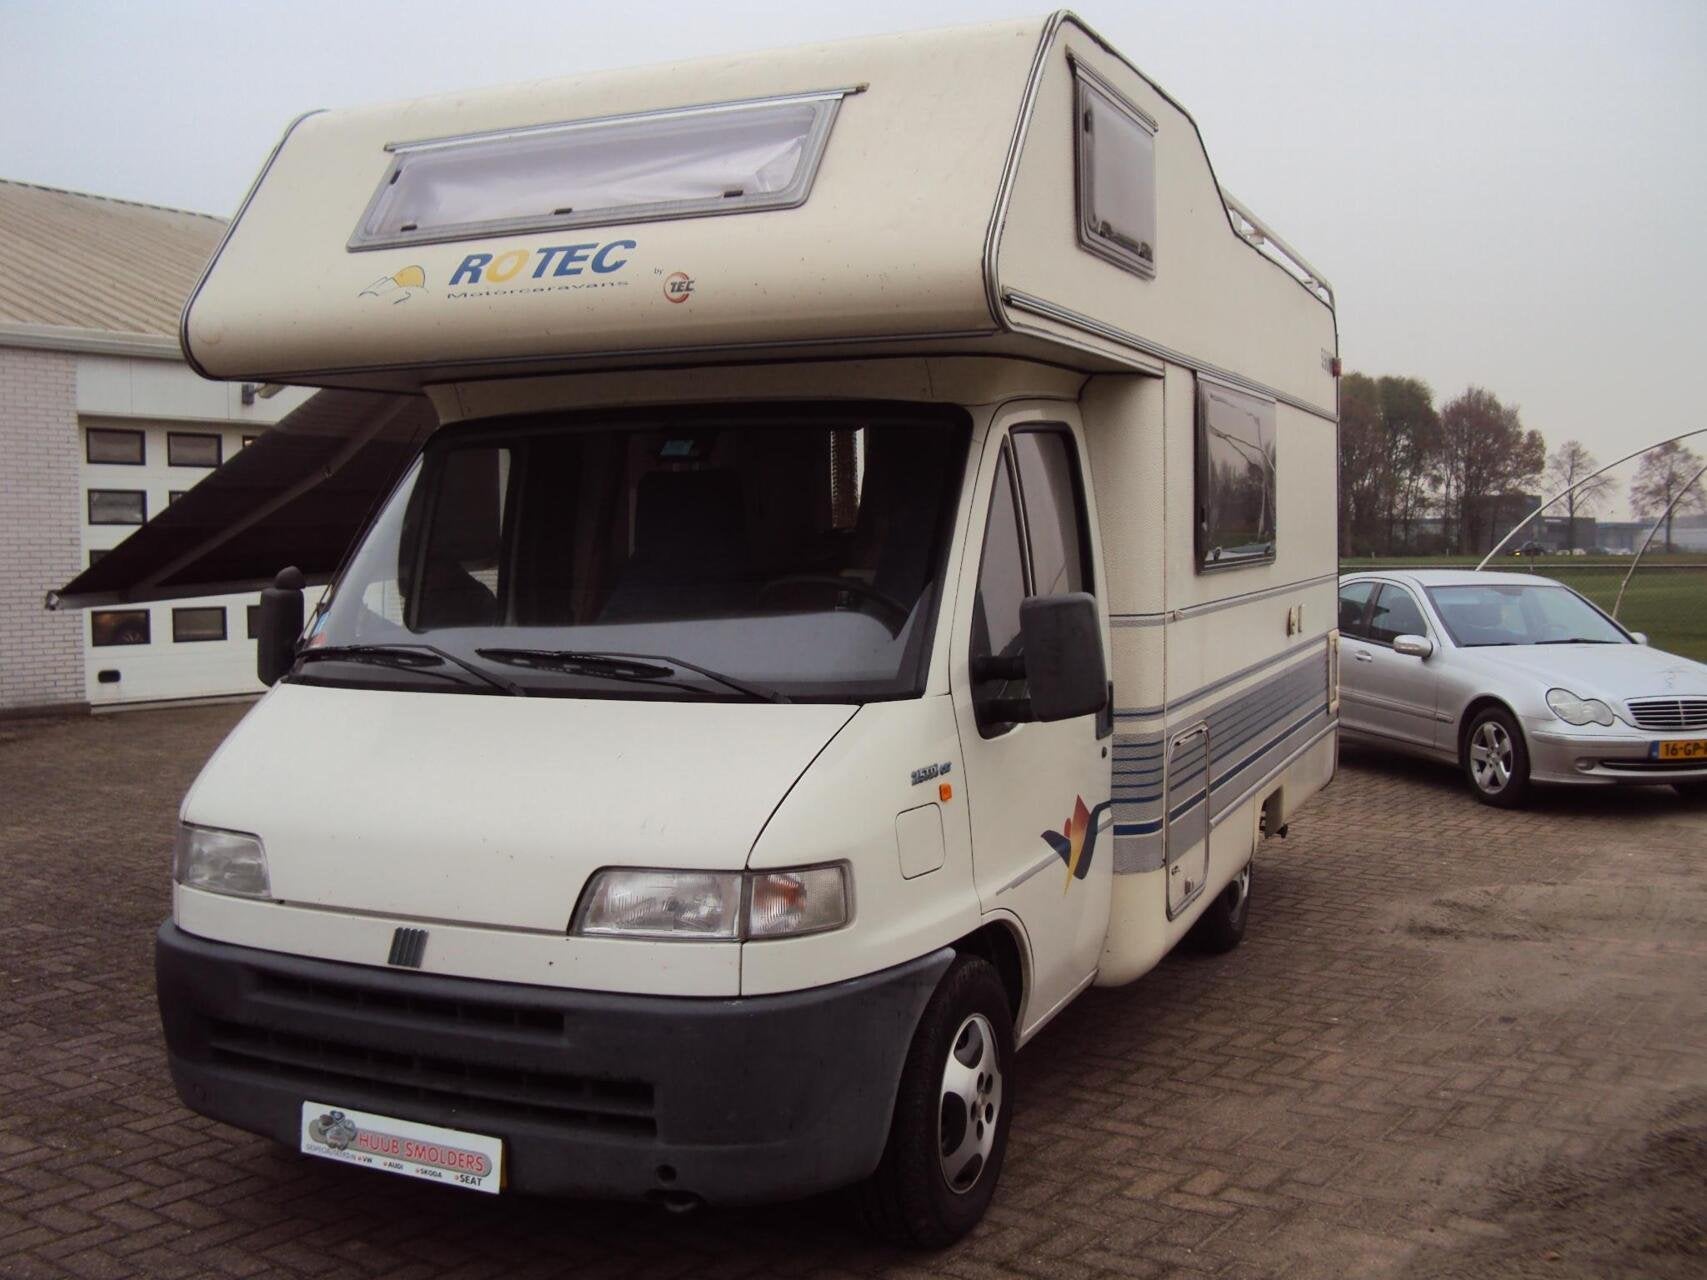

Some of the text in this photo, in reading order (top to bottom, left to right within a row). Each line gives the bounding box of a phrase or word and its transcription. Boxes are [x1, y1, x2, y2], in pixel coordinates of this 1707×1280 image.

[448, 240, 637, 286] ROTEC
[447, 281, 630, 299] Motorcaravans
[670, 279, 695, 293] TEC
[358, 1133, 400, 1155] HUUB
[405, 1140, 485, 1172] SMOLDERS
[460, 1174, 482, 1187] SEAT
